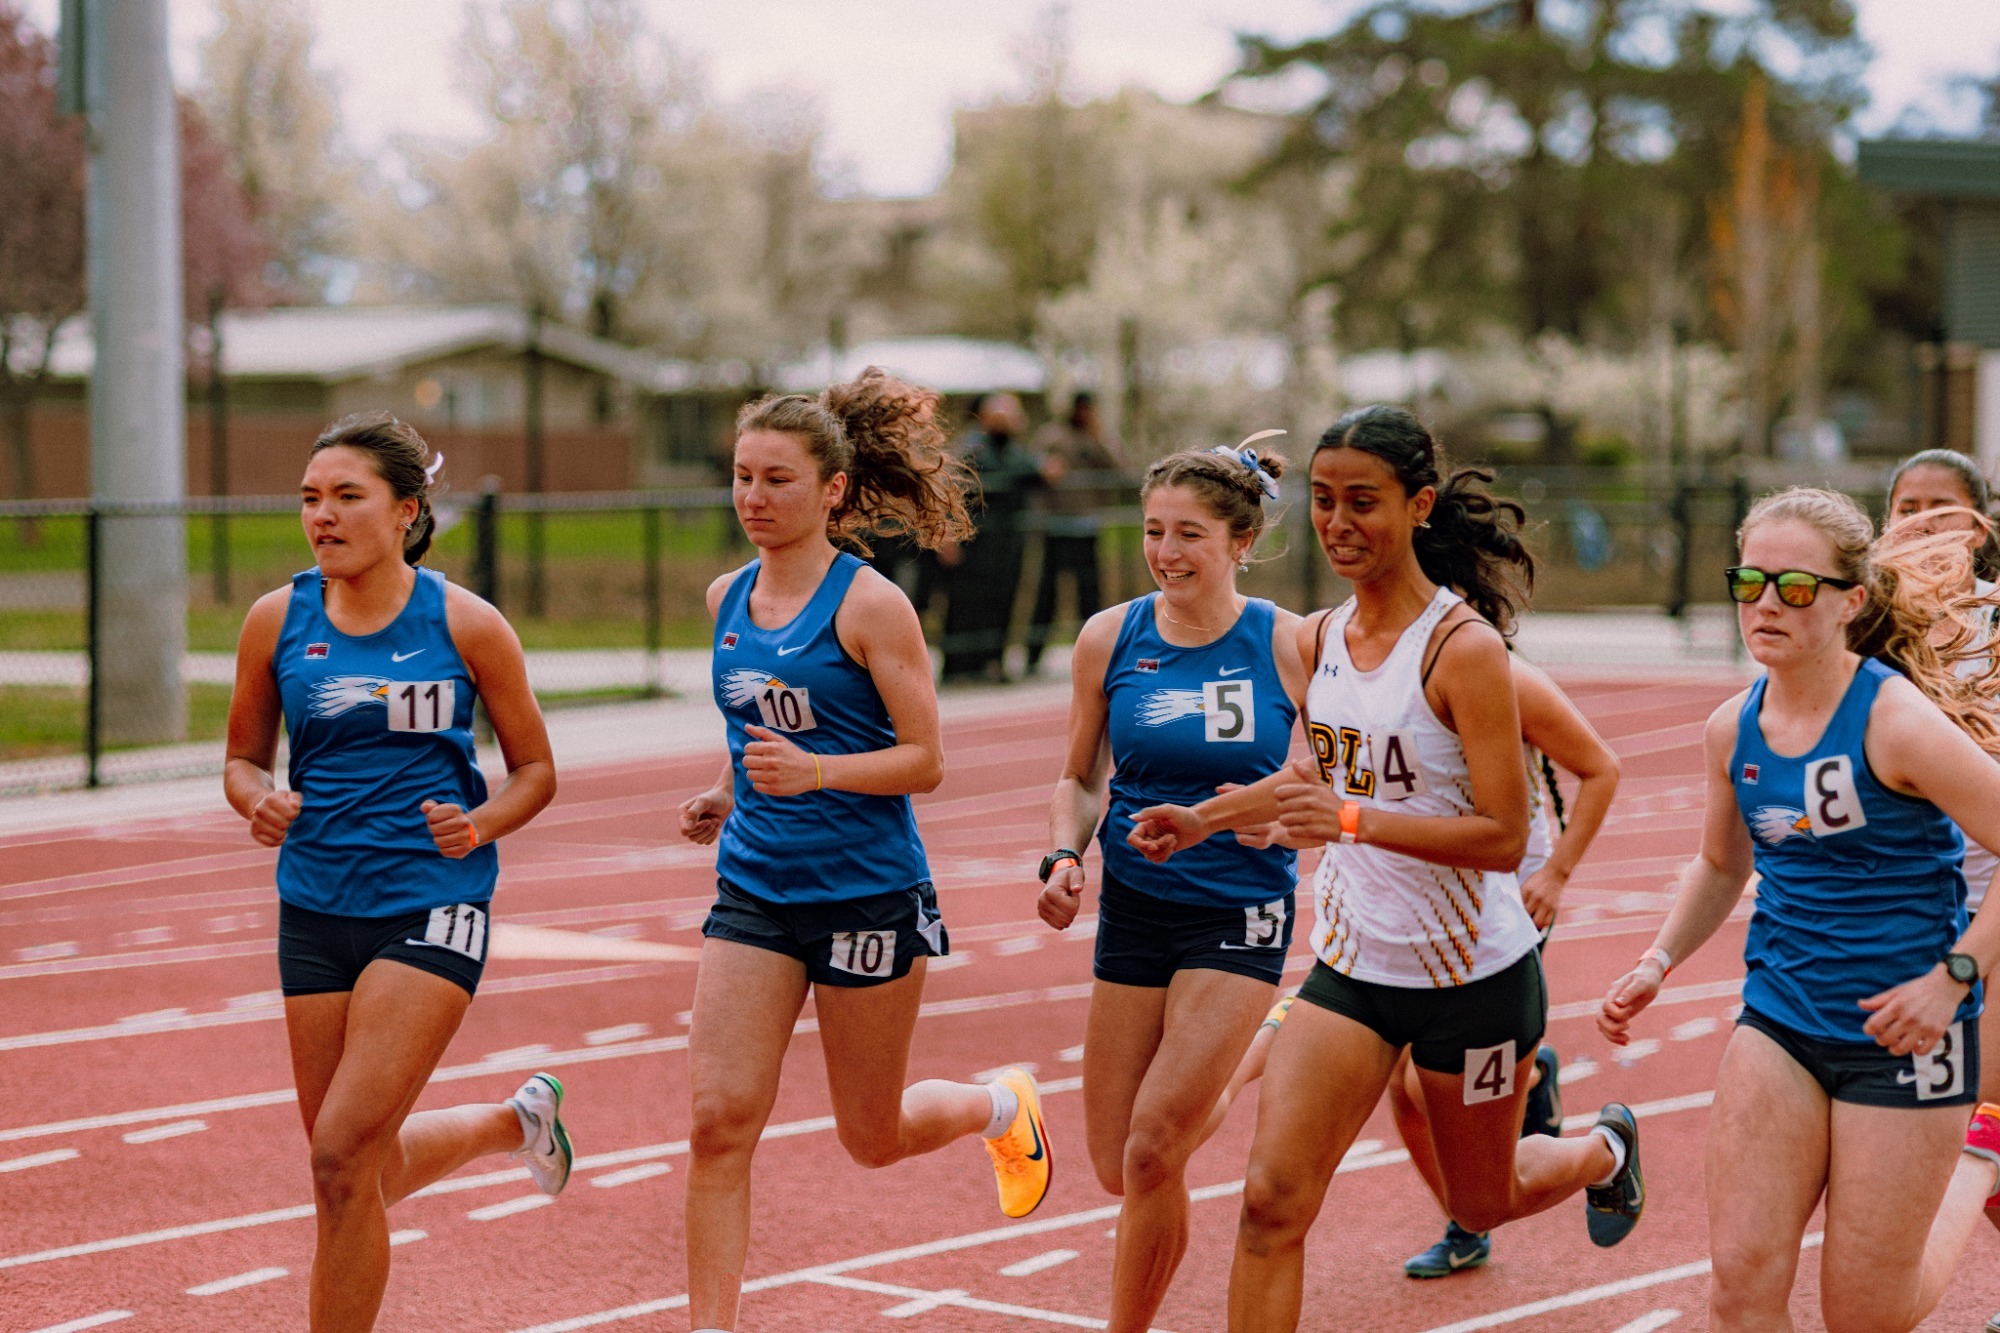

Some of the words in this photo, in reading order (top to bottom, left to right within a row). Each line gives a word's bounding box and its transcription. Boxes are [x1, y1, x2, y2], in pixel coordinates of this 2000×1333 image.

[400, 683, 440, 730] 11
[763, 688, 802, 731] 10
[1216, 684, 1244, 738] 5
[1383, 735, 1417, 793] 4
[443, 904, 476, 953] 11
[1256, 904, 1279, 946] 5
[843, 932, 884, 974] 10
[1473, 1048, 1507, 1097] 4
[1930, 1029, 1955, 1094] 3
